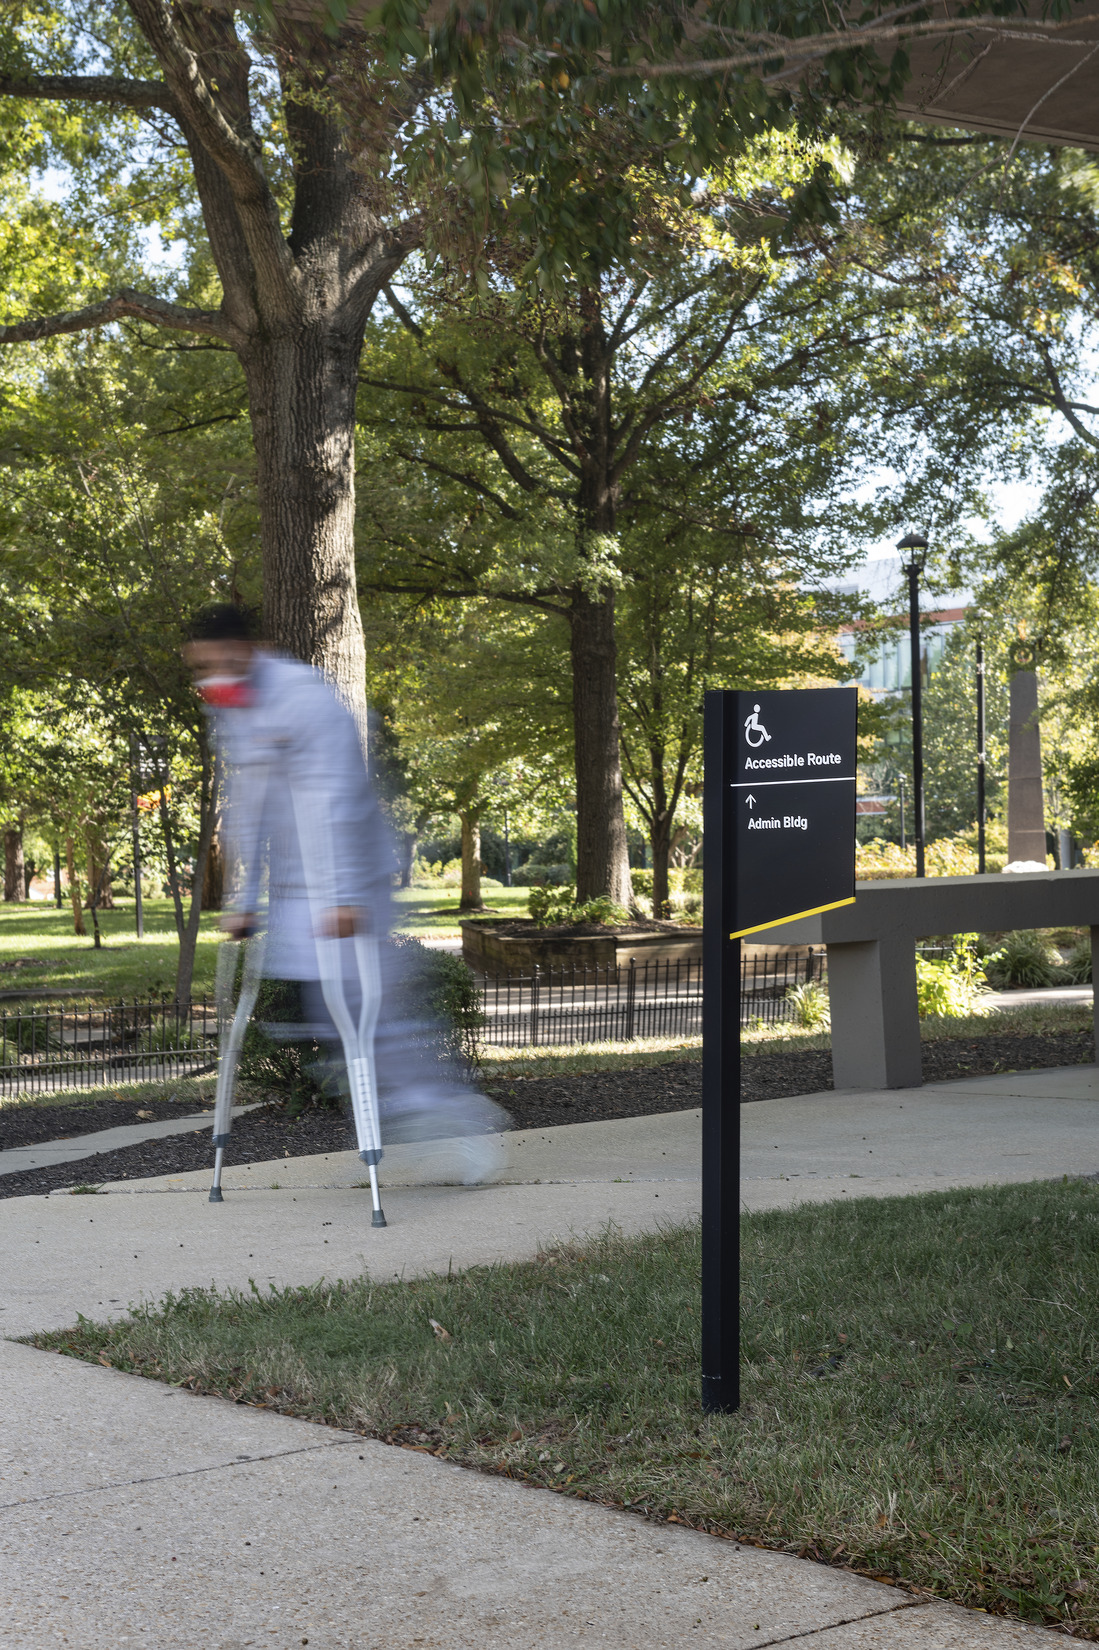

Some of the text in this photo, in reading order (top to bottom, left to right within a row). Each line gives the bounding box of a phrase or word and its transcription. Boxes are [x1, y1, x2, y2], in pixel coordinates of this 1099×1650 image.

[745, 753, 842, 770] Accessible Route
[748, 816, 808, 831] Admin Bldg
